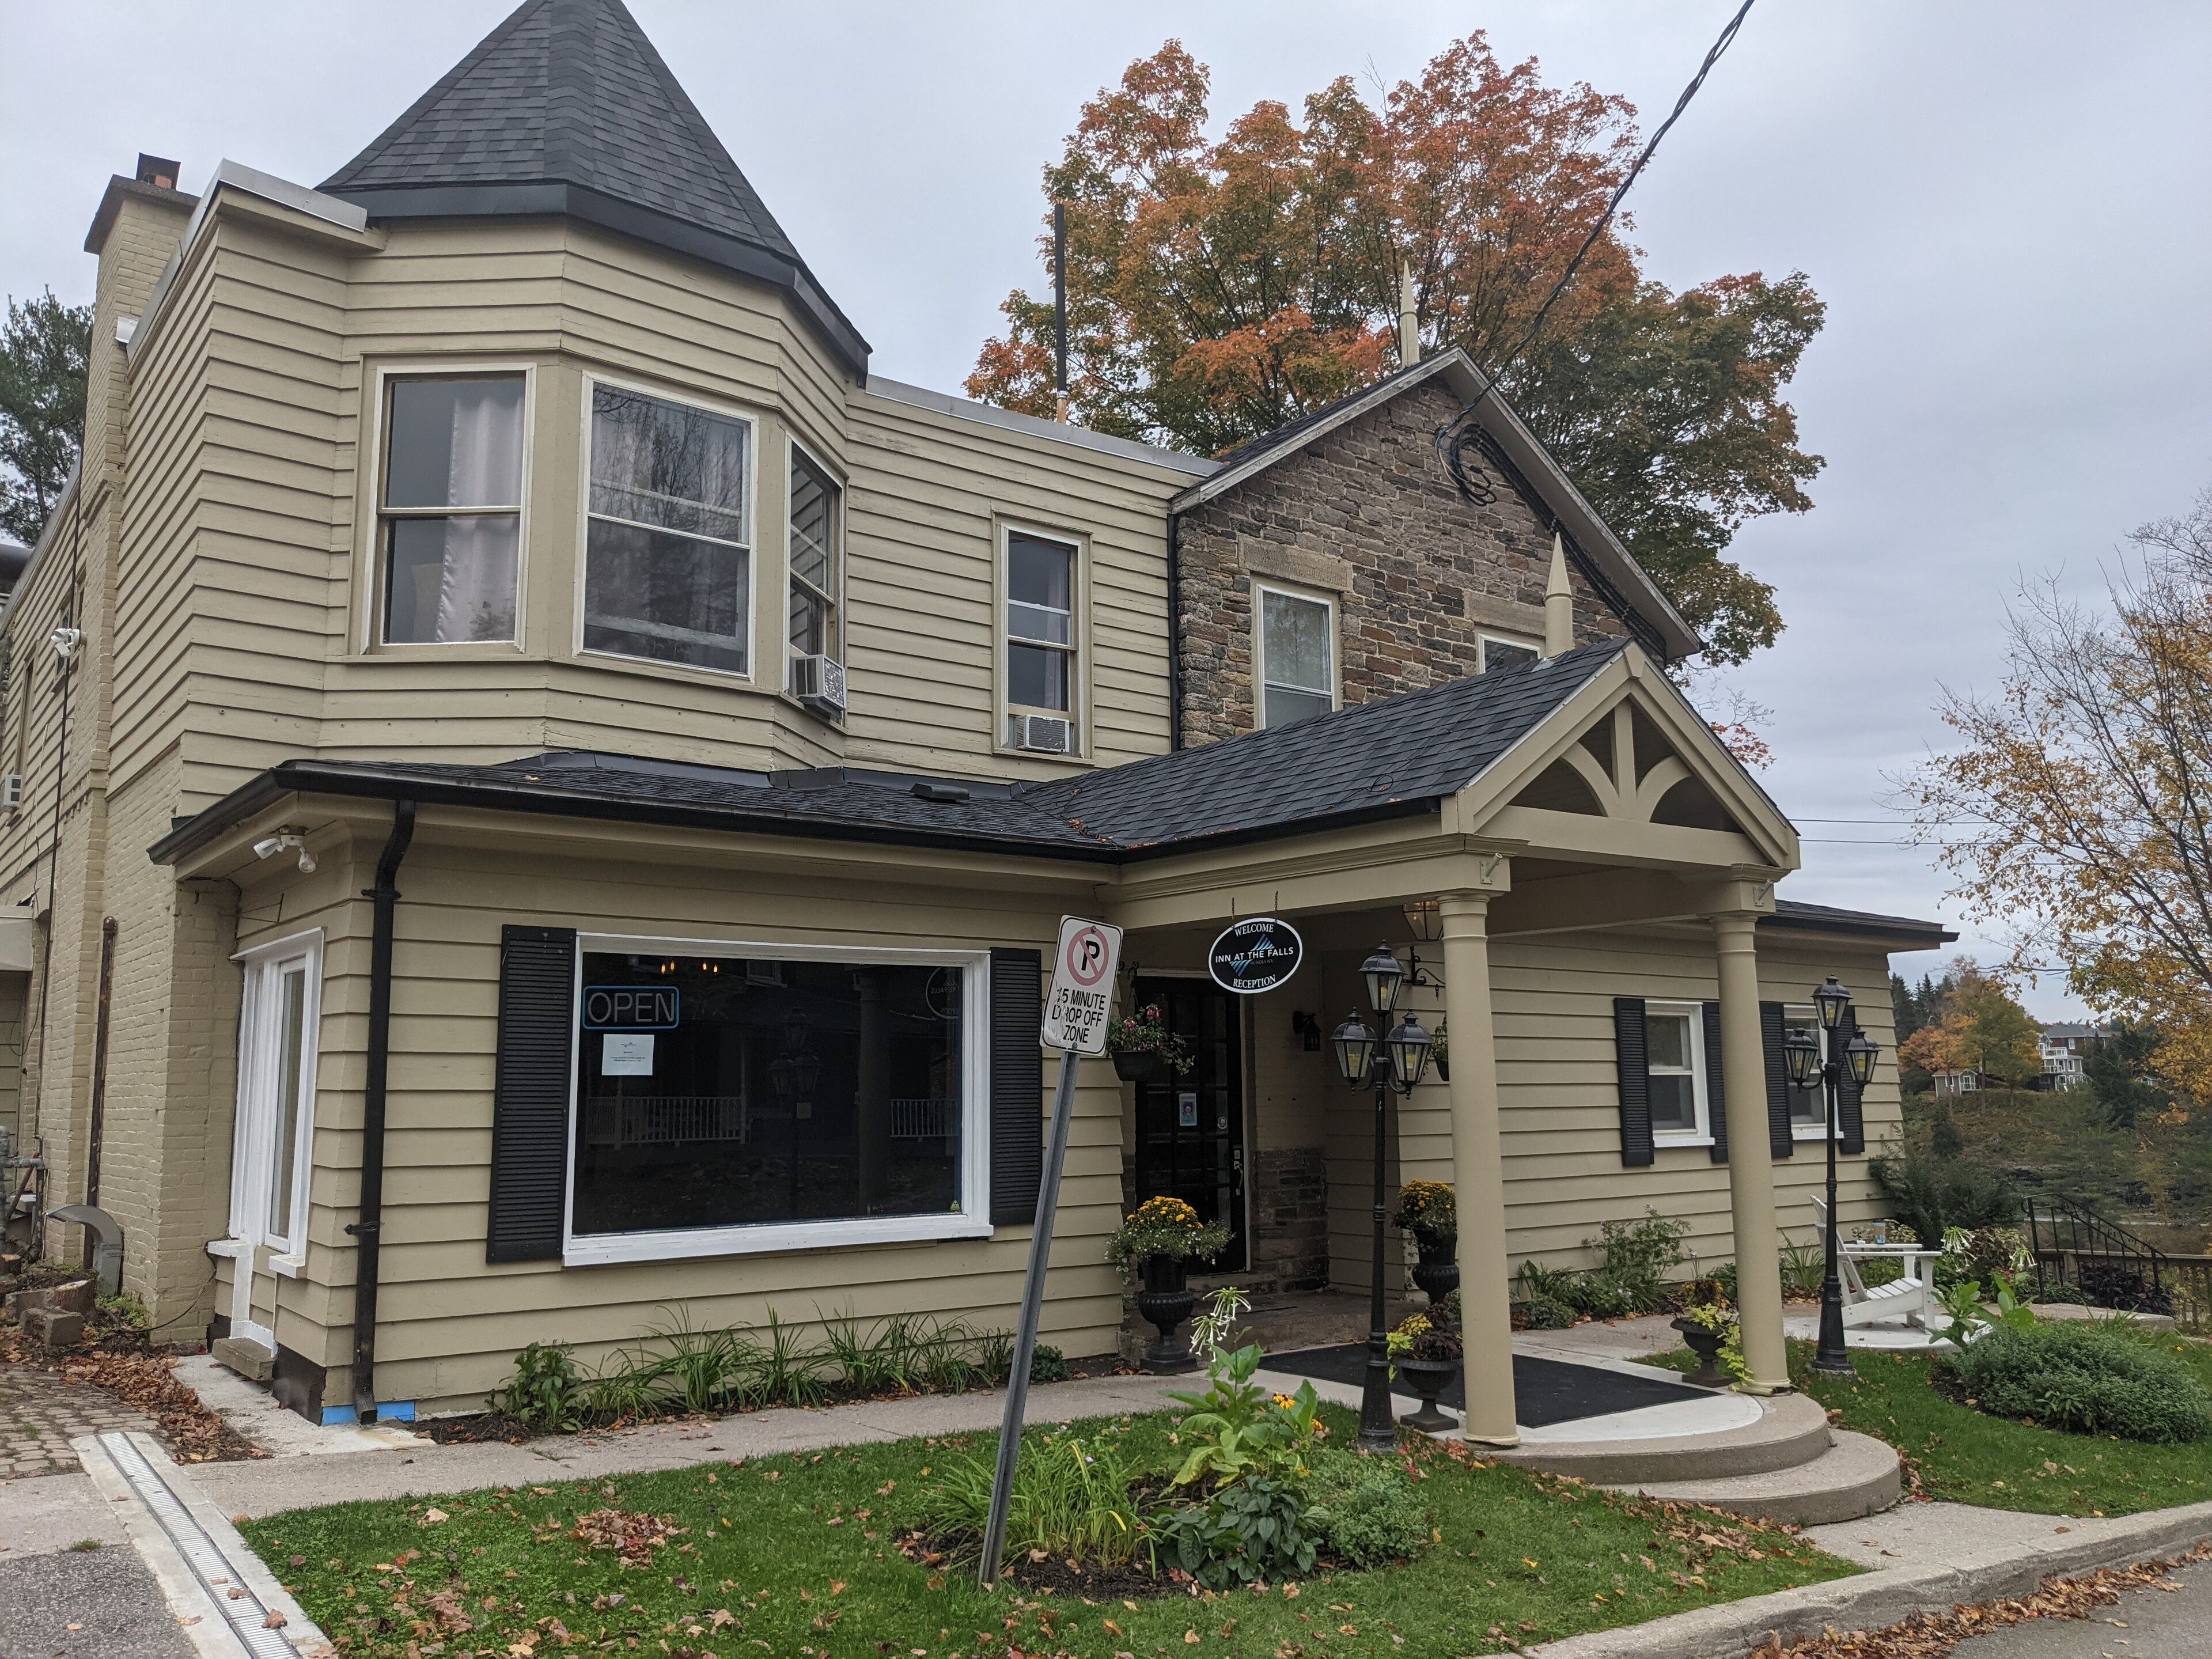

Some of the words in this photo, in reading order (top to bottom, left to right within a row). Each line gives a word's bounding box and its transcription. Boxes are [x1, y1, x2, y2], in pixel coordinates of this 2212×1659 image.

[1234, 923, 1274, 937] WELCOME
[1215, 954, 1231, 963] INN
[1234, 952, 1245, 961] AT
[1247, 950, 1264, 959] THE
[1267, 946, 1294, 957] FALLS
[1233, 974, 1276, 988] RECEPTION
[588, 992, 675, 1024] OPEN
[1070, 989, 1107, 1010] MINUTE
[1084, 1010, 1103, 1027] OFF
[1063, 1024, 1090, 1043] ZONE
